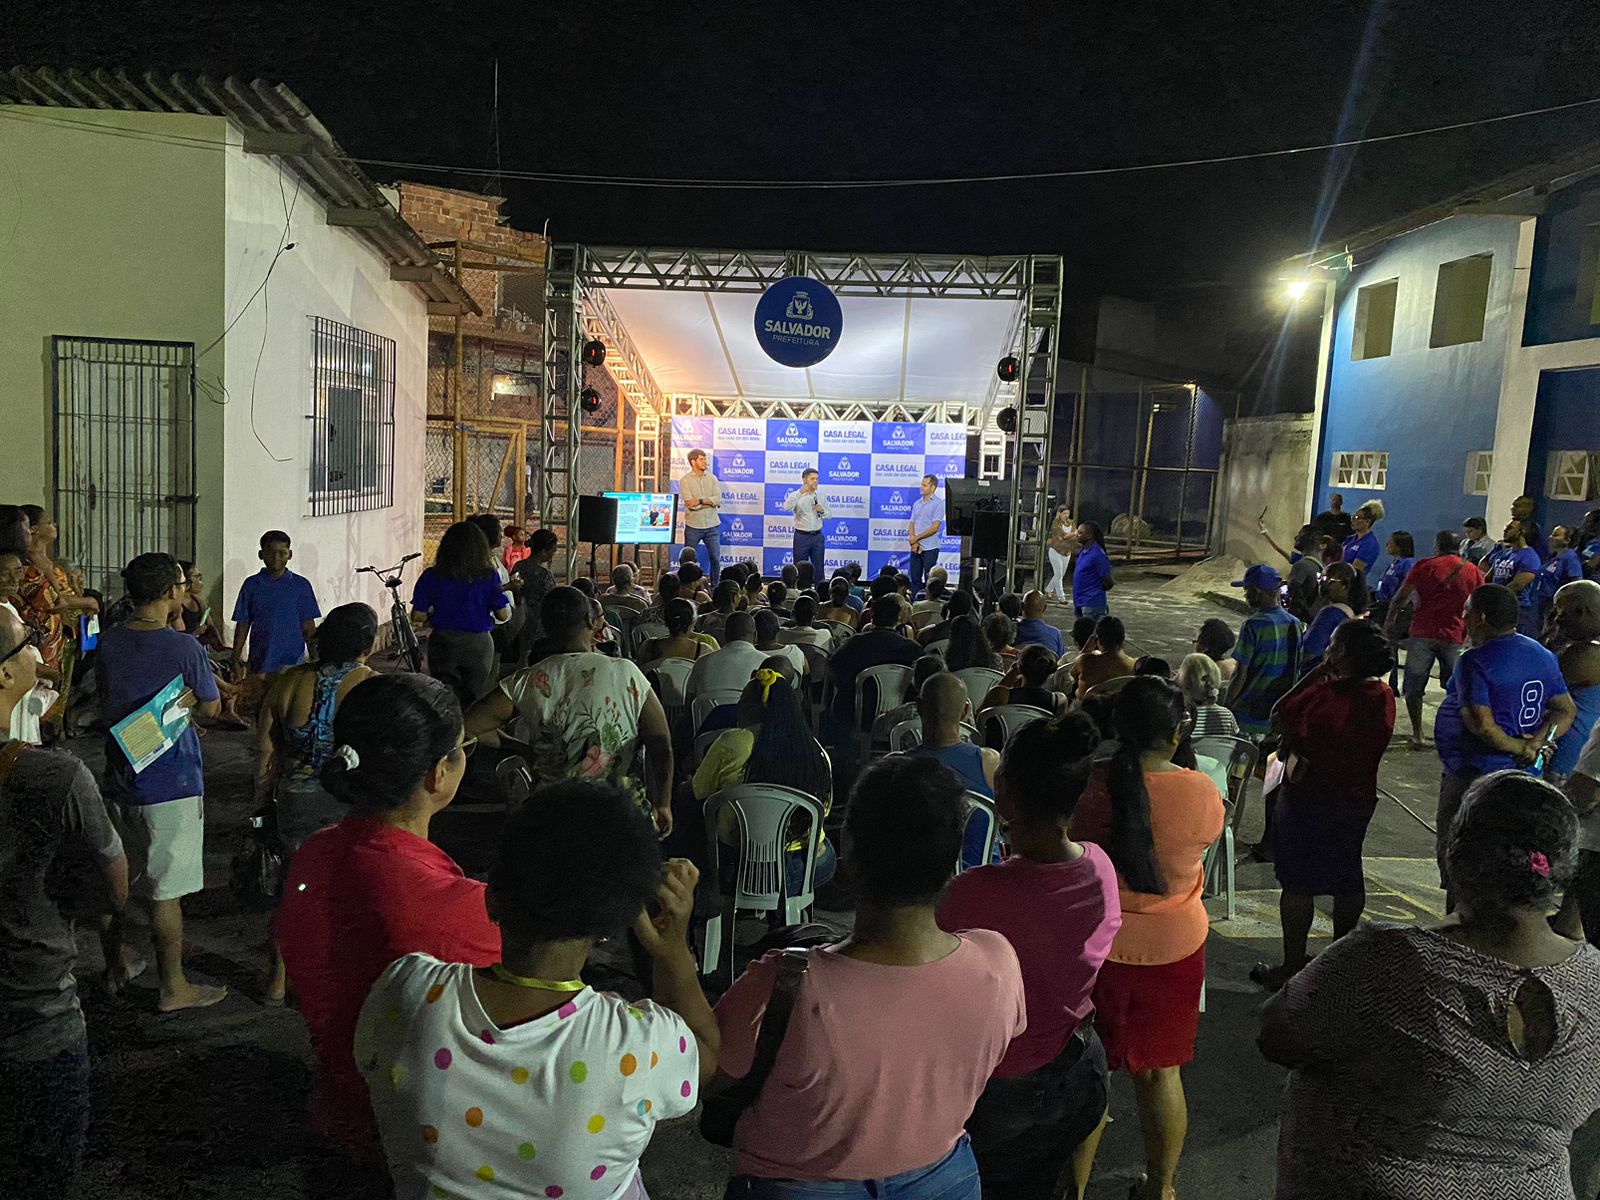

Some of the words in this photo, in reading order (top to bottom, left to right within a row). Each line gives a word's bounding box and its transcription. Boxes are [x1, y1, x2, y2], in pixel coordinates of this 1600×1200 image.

[764, 320, 831, 339] SALVADOR
[773, 334, 820, 346] PREFEITURA
[718, 427, 737, 435] CASA
[823, 430, 843, 438] CASA
[776, 436, 808, 444] SALVADOR
[930, 432, 949, 440] CASA
[769, 461, 788, 469] CASA
[875, 463, 894, 472] CASA
[723, 467, 754, 475] SALVADOR
[828, 470, 860, 478] SALVADOR
[721, 492, 736, 500] ASA
[826, 495, 840, 503] ASA
[768, 525, 787, 533] CASA
[873, 528, 892, 536] CASA
[826, 535, 858, 543] SALVADOR
[720, 555, 734, 563] ASA
[824, 559, 838, 567] ASA
[1518, 680, 1544, 727] 8
